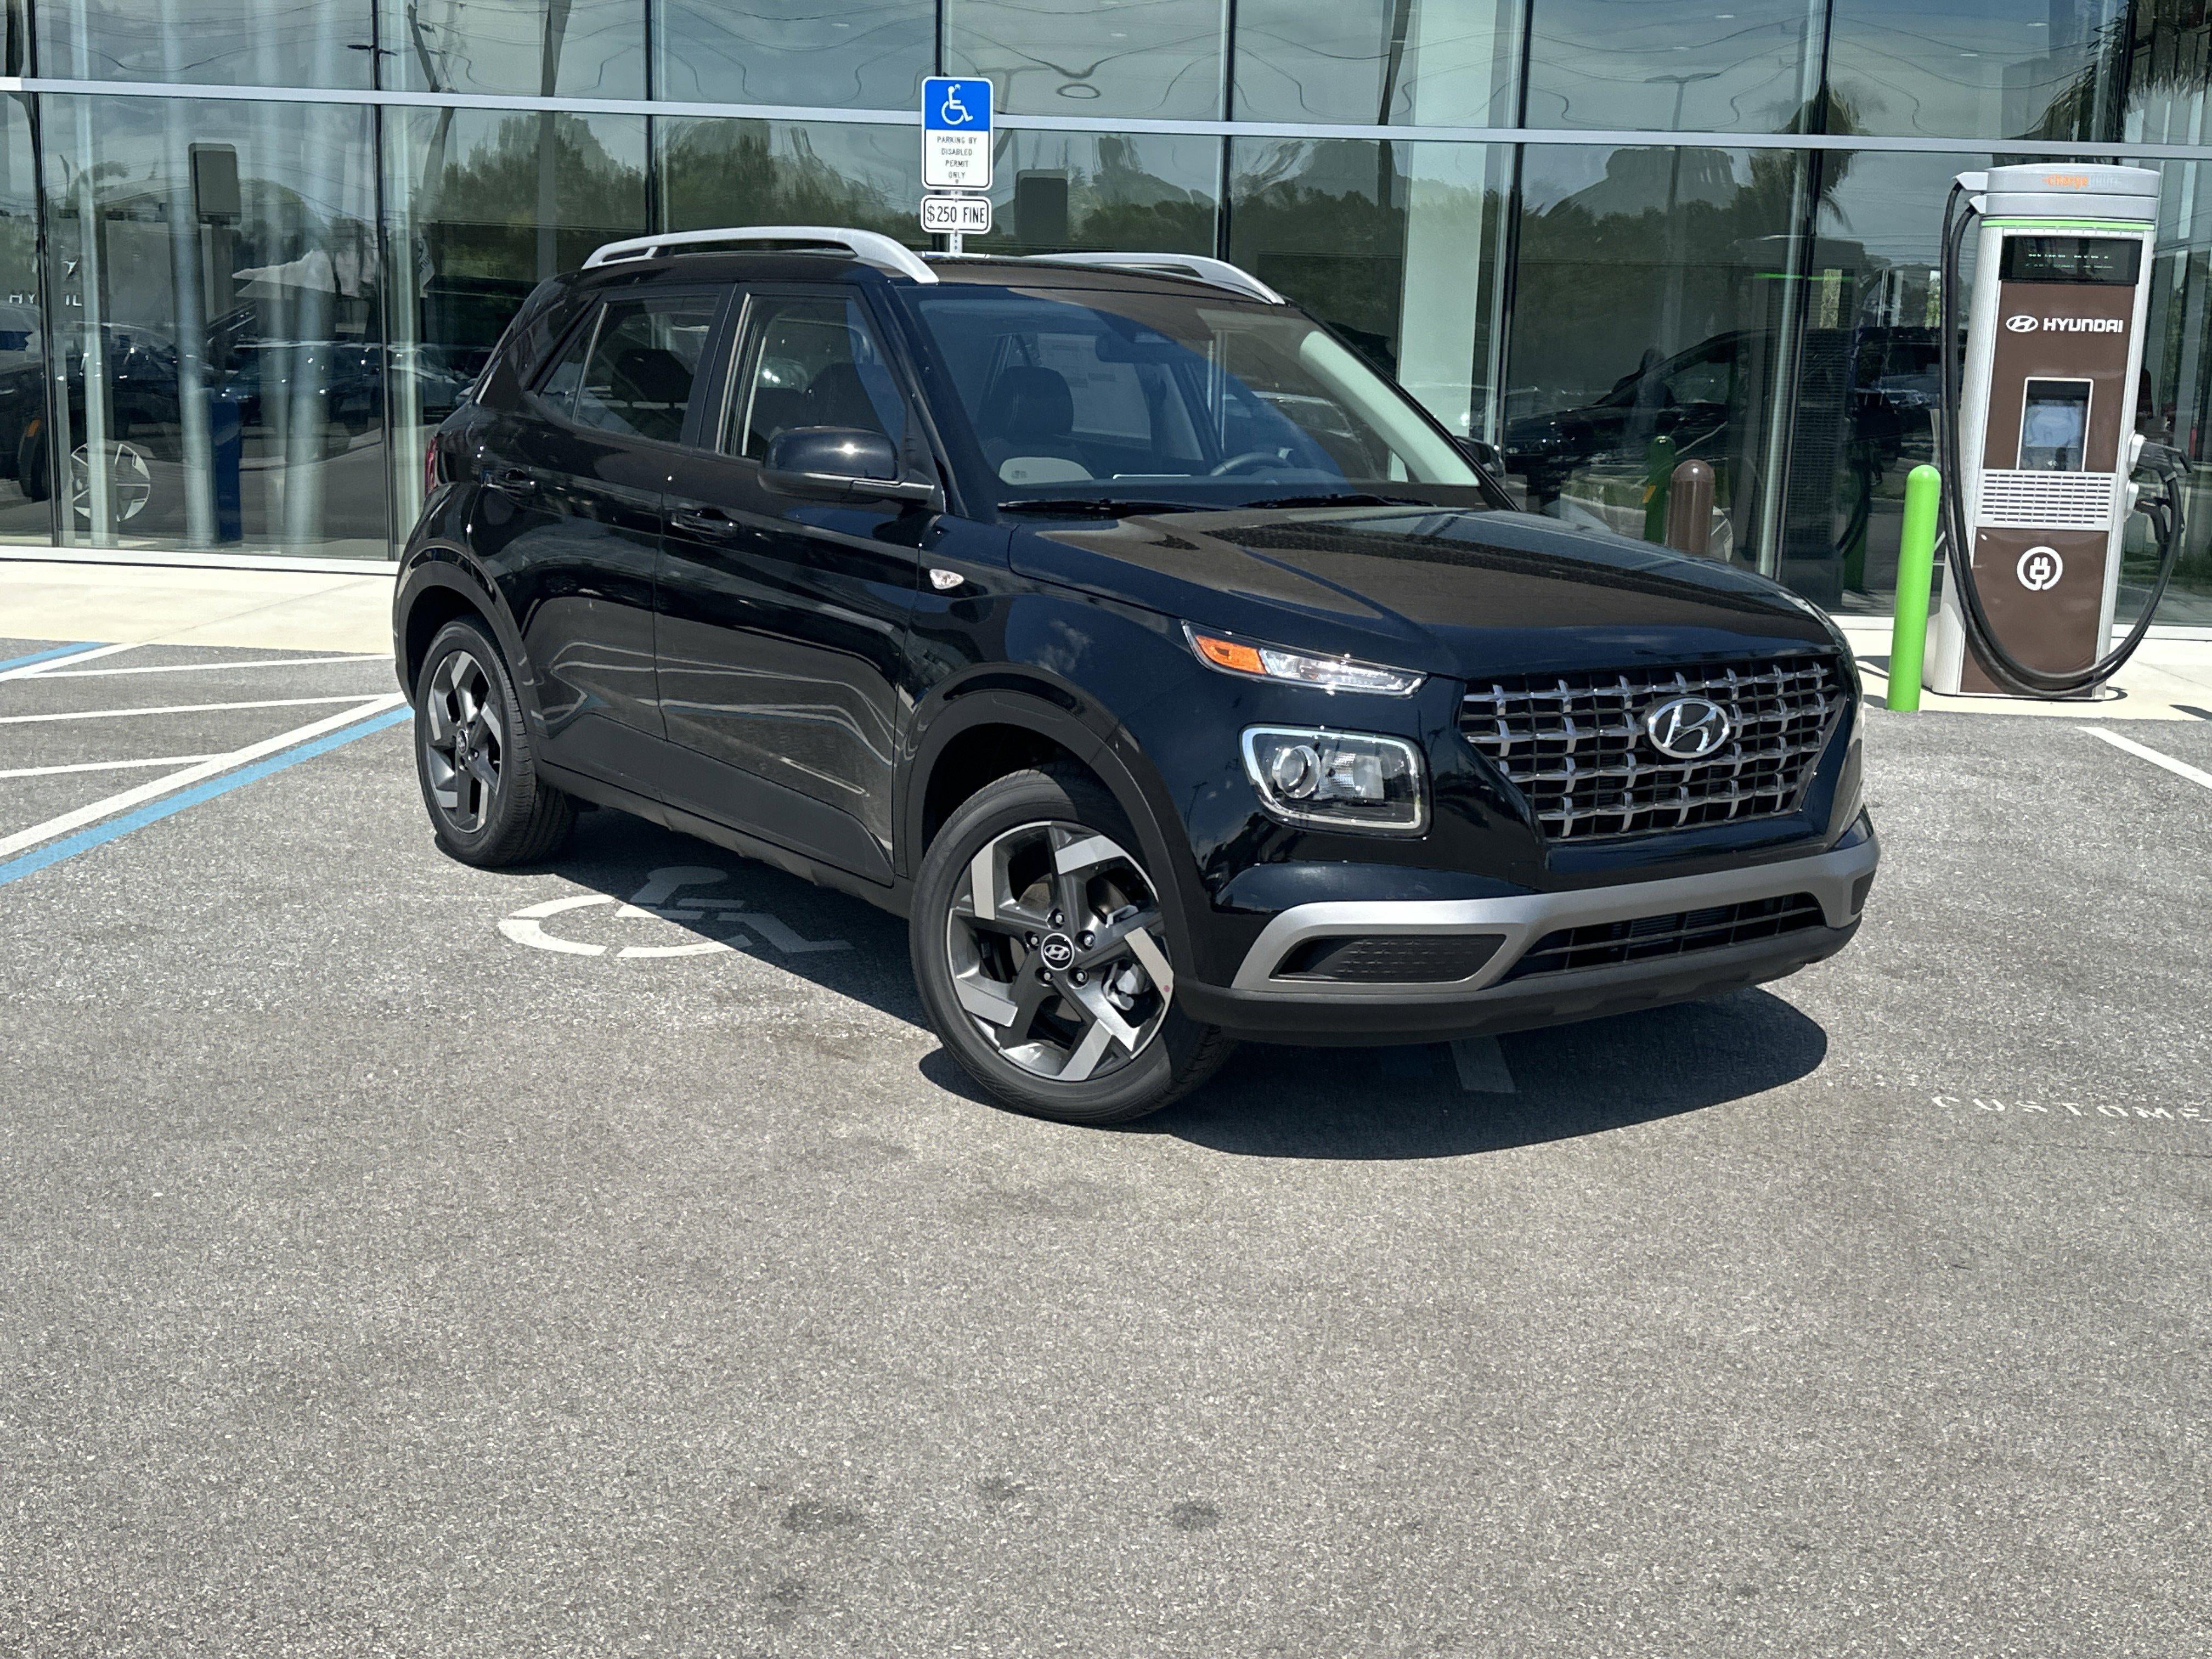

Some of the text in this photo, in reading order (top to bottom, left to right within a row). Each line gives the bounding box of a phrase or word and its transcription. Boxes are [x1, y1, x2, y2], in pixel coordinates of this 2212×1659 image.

[936, 136, 966, 144] PARKING
[941, 147, 973, 156] DISABLED
[948, 171, 966, 179] ONLY
[926, 204, 985, 223] $250 FINE
[2043, 318, 2123, 332] HYUNDAI
